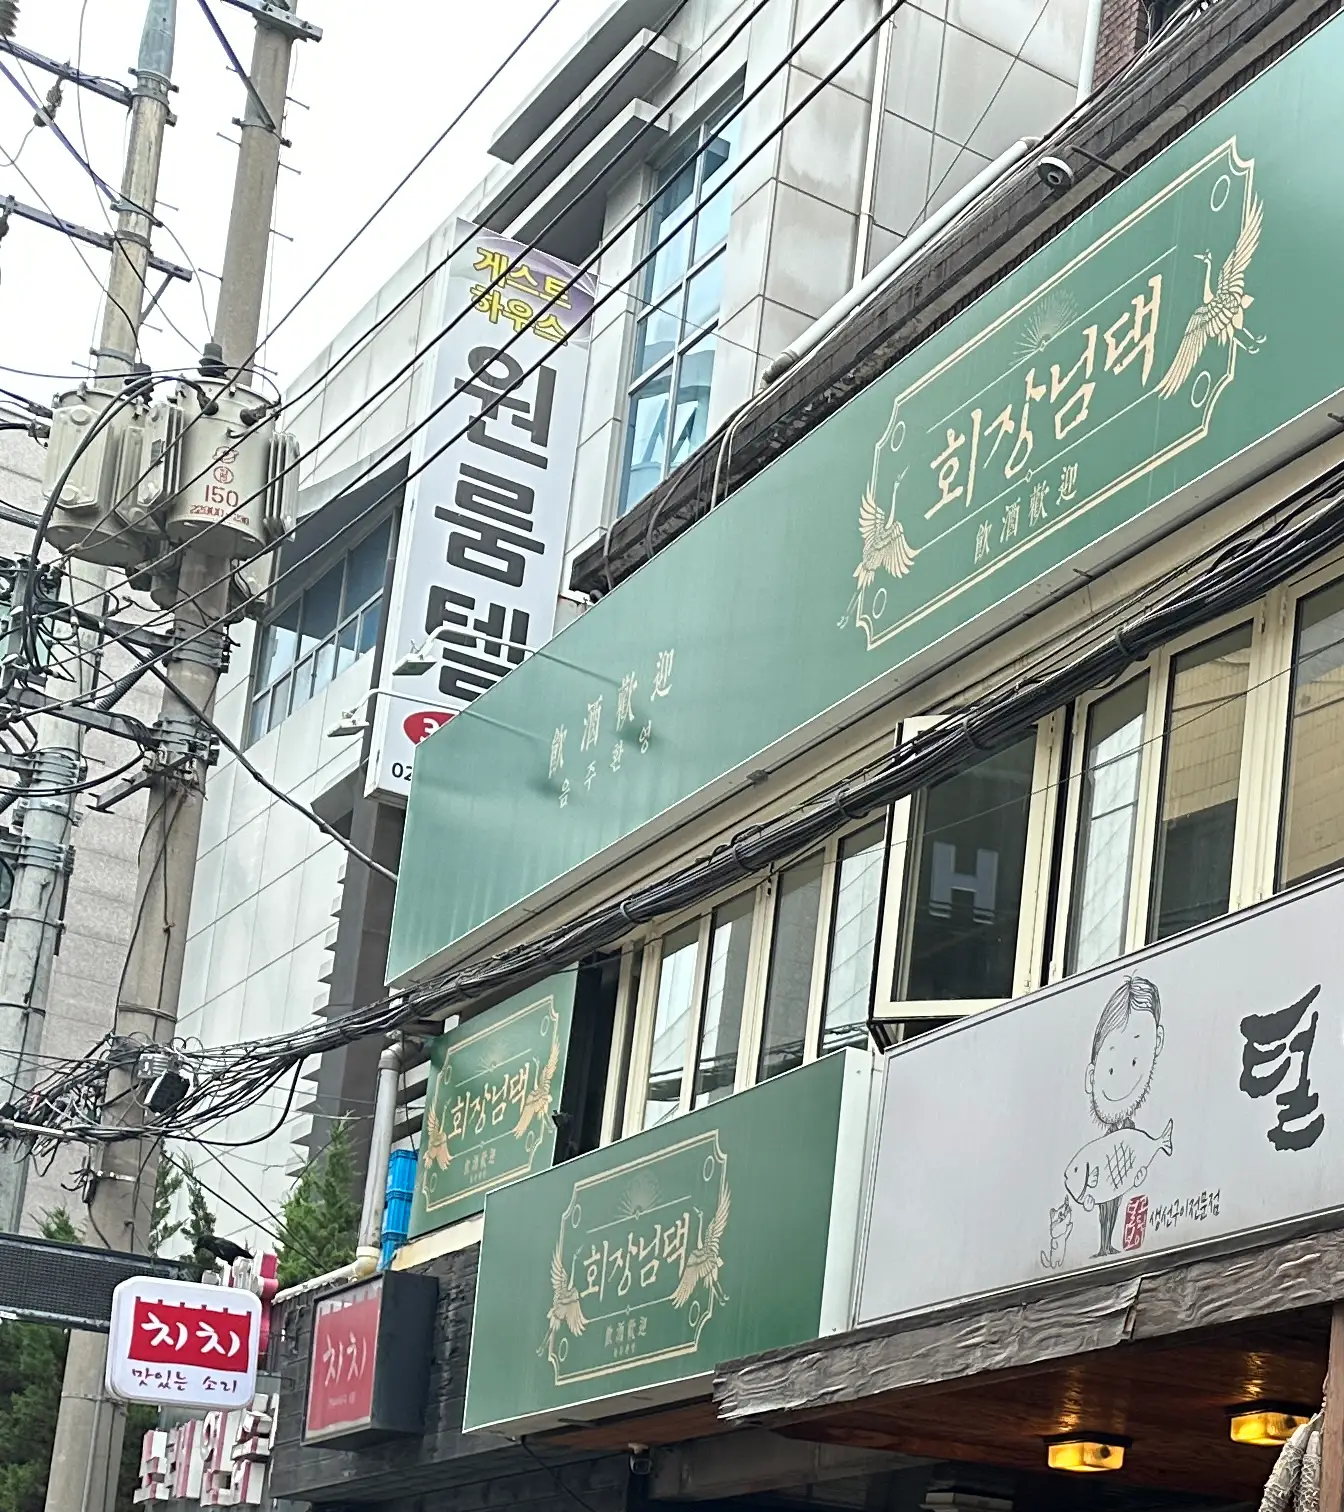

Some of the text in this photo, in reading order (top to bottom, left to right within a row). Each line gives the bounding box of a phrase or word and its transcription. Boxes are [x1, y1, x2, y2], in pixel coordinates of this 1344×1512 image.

[473, 246, 572, 310] 게스트
[470, 284, 568, 347] 하우스
[205, 485, 239, 507] 150
[140, 1311, 241, 1358] 치치
[132, 1367, 238, 1393] 맛있는 소리
